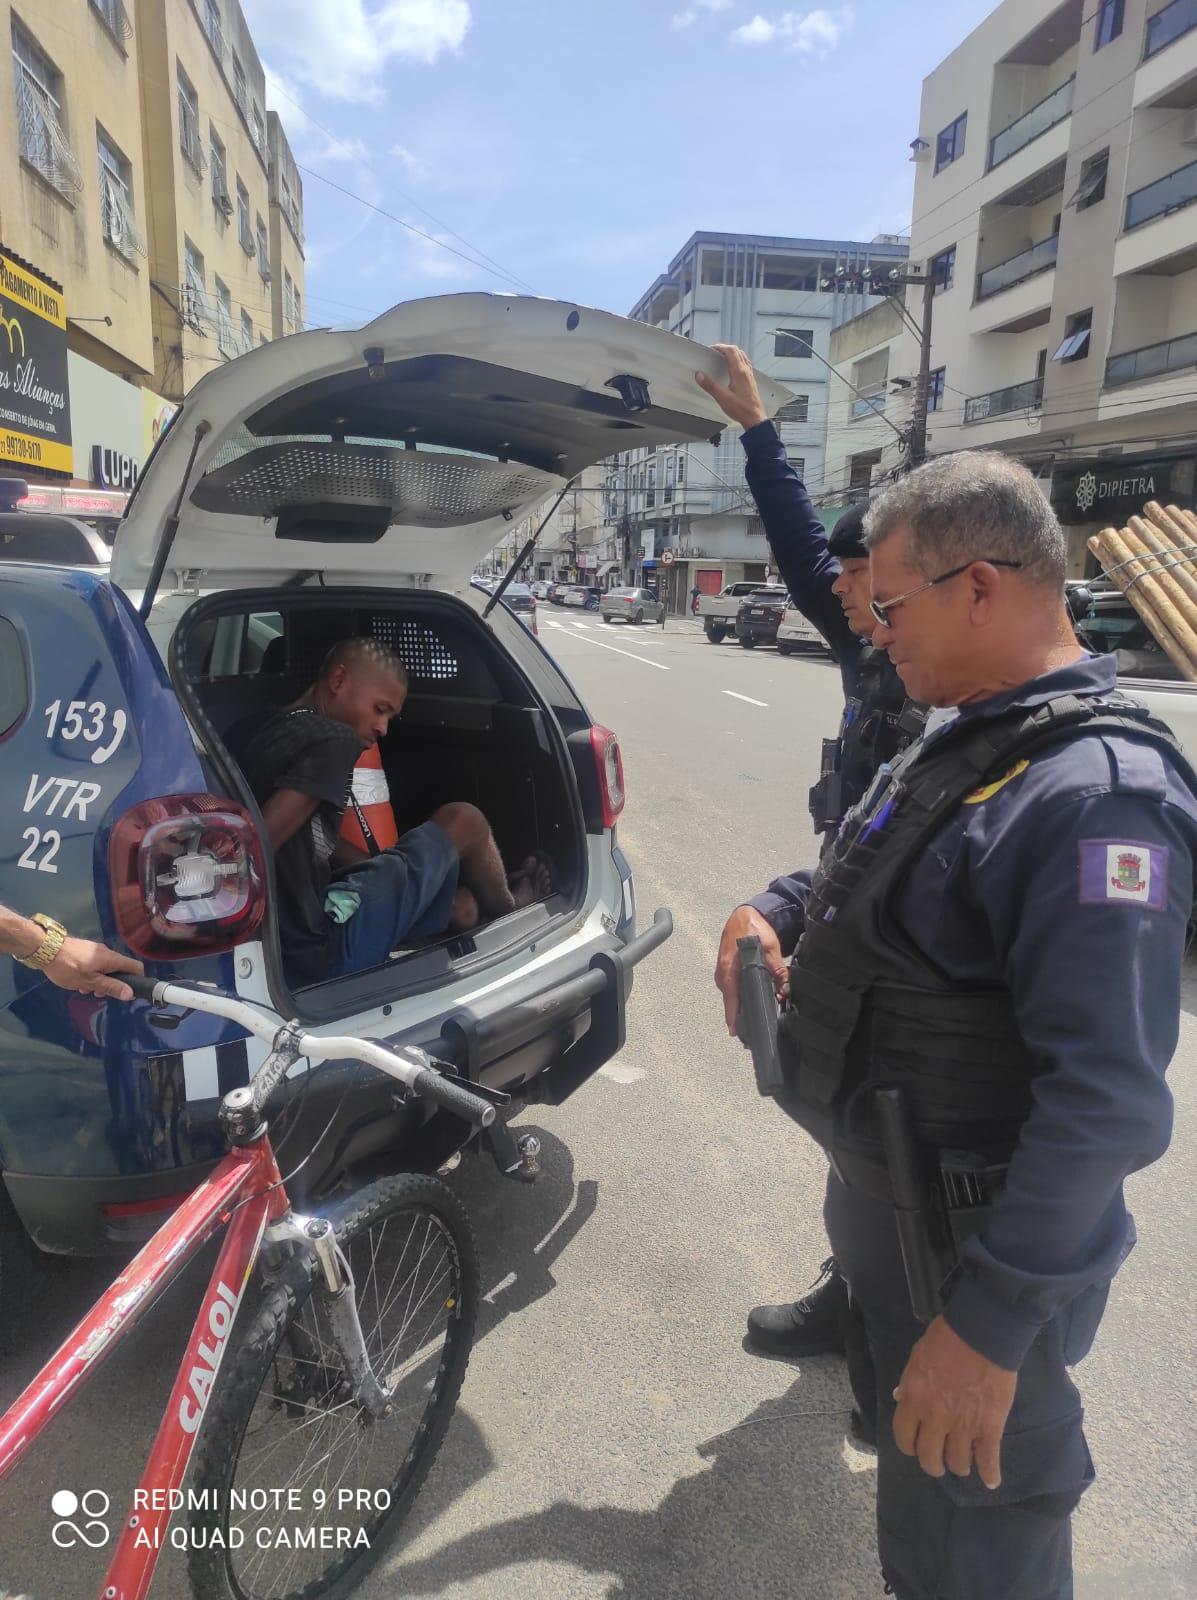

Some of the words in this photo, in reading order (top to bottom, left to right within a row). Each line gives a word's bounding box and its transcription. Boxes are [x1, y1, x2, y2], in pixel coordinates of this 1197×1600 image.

[1, 267, 38, 307] PAGAMENTO
[43, 293, 60, 320] VISTA
[14, 358, 66, 415] Alianças
[1099, 477, 1155, 498] DIPIETRA
[44, 699, 106, 742] 153
[22, 773, 101, 821] VTR
[17, 826, 62, 873] 22
[179, 1281, 238, 1434] CALOI
